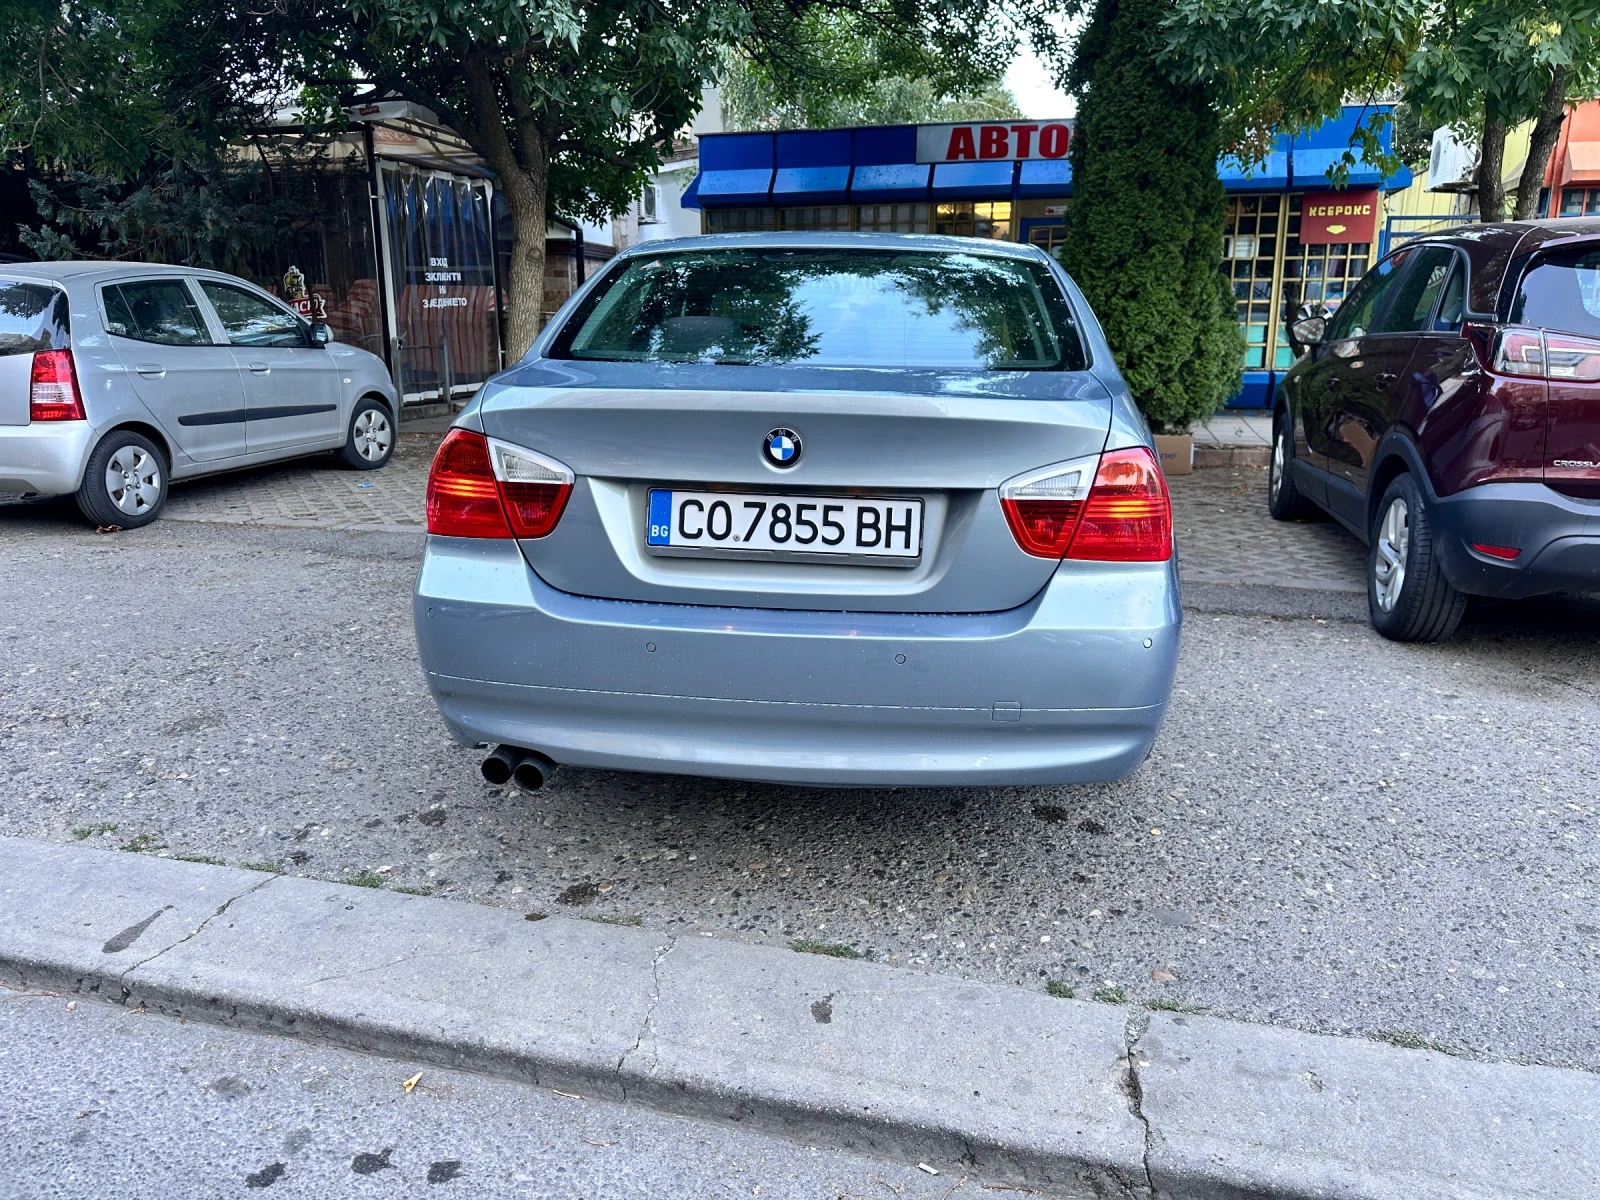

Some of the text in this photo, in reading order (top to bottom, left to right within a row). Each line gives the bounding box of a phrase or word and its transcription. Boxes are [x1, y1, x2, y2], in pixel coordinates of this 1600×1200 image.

[946, 124, 1078, 160] АВТО
[1309, 205, 1371, 216] КСЕРОКС
[767, 430, 799, 442] BMW
[743, 501, 845, 546] 7855
[651, 525, 669, 537] BG
